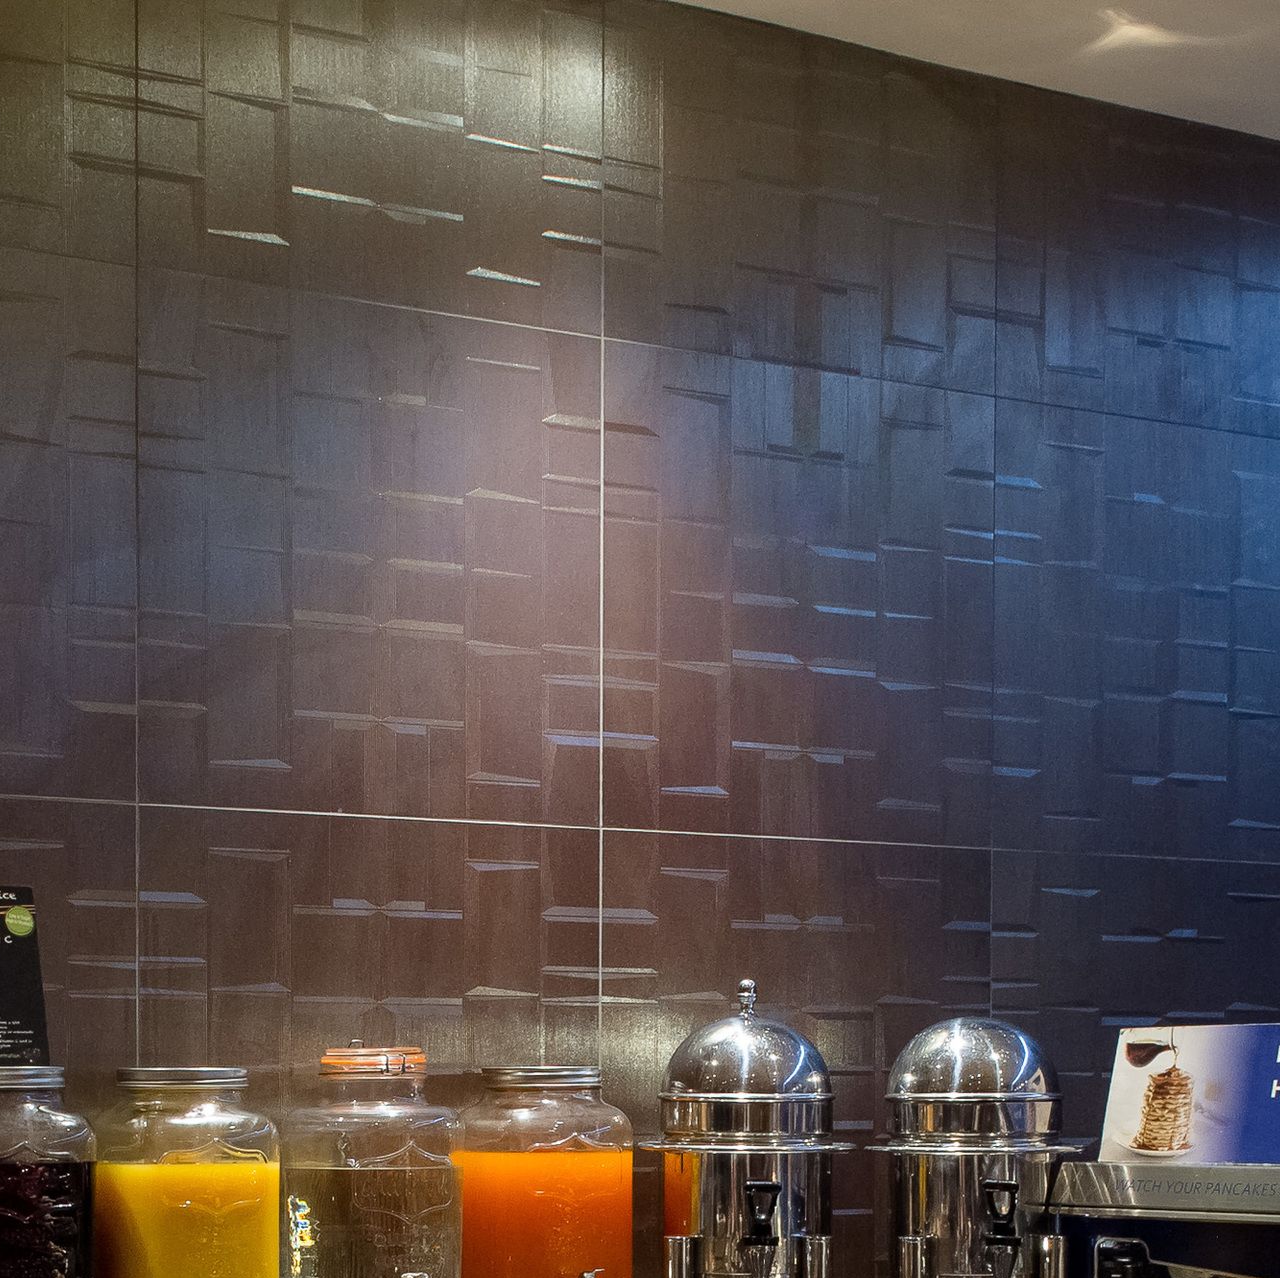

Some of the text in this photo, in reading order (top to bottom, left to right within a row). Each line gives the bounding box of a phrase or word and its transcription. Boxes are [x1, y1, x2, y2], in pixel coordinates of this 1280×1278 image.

[4, 935, 13, 944] C
[1115, 1180, 1161, 1194] WATCH
[1166, 1181, 1203, 1194] YOUR
[1205, 1182, 1278, 1197] PANCAKES
